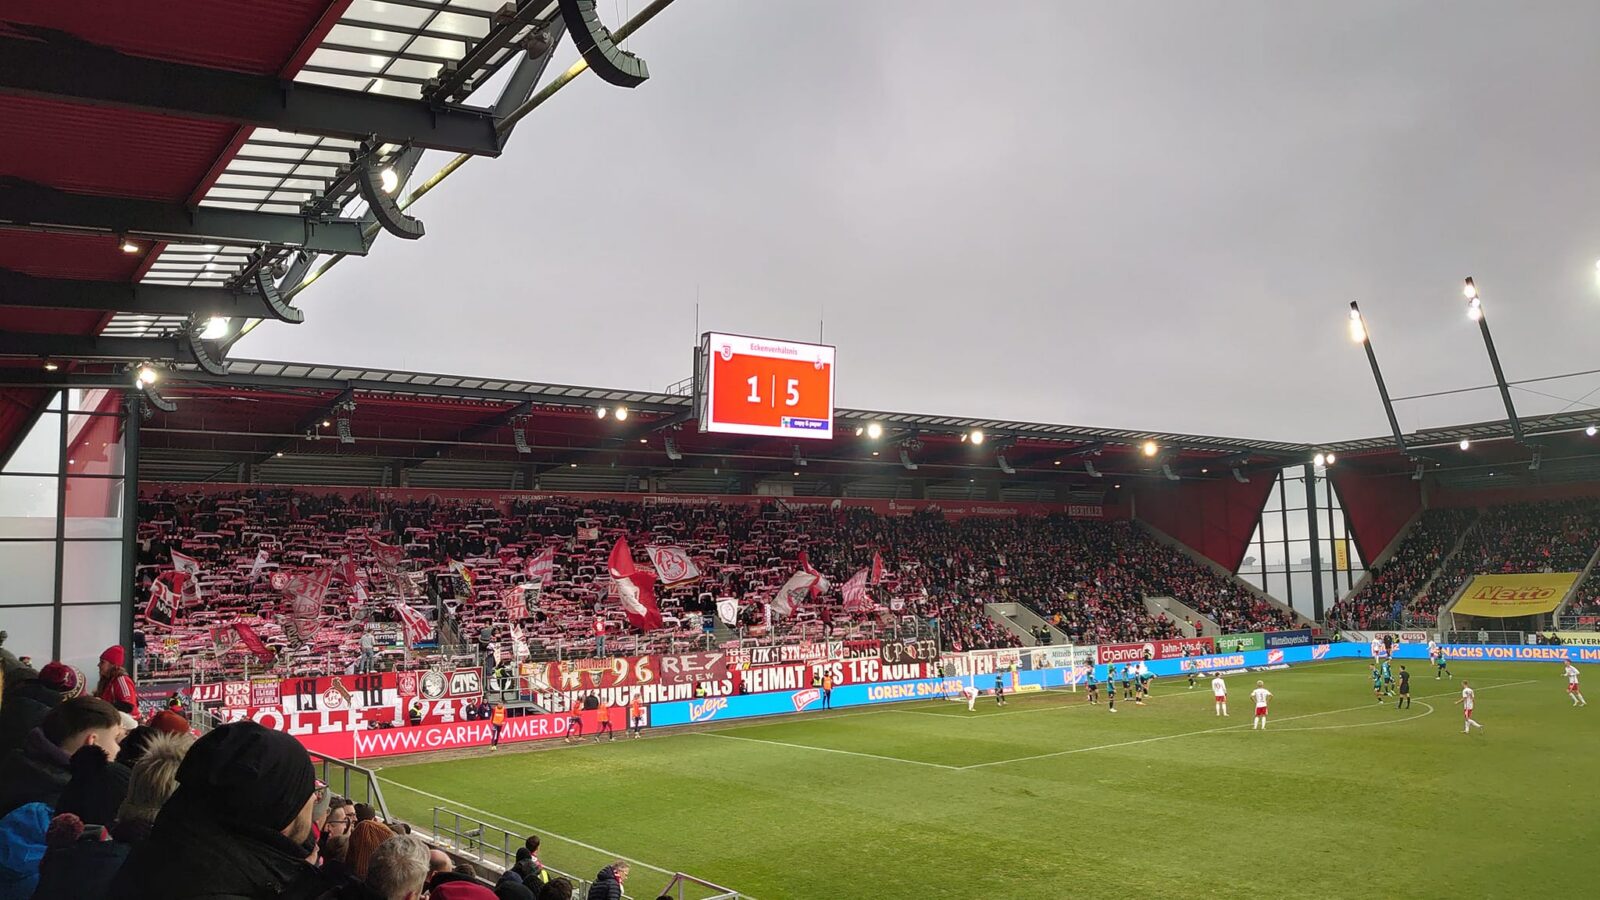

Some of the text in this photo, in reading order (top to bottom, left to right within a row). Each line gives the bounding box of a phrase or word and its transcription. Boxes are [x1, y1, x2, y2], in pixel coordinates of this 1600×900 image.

[749, 343, 798, 356] Eckenverhältnis
[747, 375, 800, 406] 1 5
[1472, 585, 1557, 601] Netto
[781, 642, 827, 660] SYNKAT
[1052, 649, 1096, 658] Mittelbyerische
[1485, 648, 1513, 658] VON
[1516, 648, 1568, 659] LORENZ
[1580, 649, 1600, 660] IM
[612, 656, 653, 687] 96
[662, 653, 724, 673] RE7
[1181, 657, 1213, 671] LOENZ
[674, 672, 714, 683] CREW
[741, 665, 806, 693] HEIMAT
[849, 659, 879, 683] 1.FC
[225, 683, 250, 694] SPS
[868, 680, 963, 700] LORENZ SNACKS
[225, 695, 250, 706] CGN
[689, 697, 728, 721] Lorenz
[356, 715, 576, 754] WWW.GARHAMMER.DE
